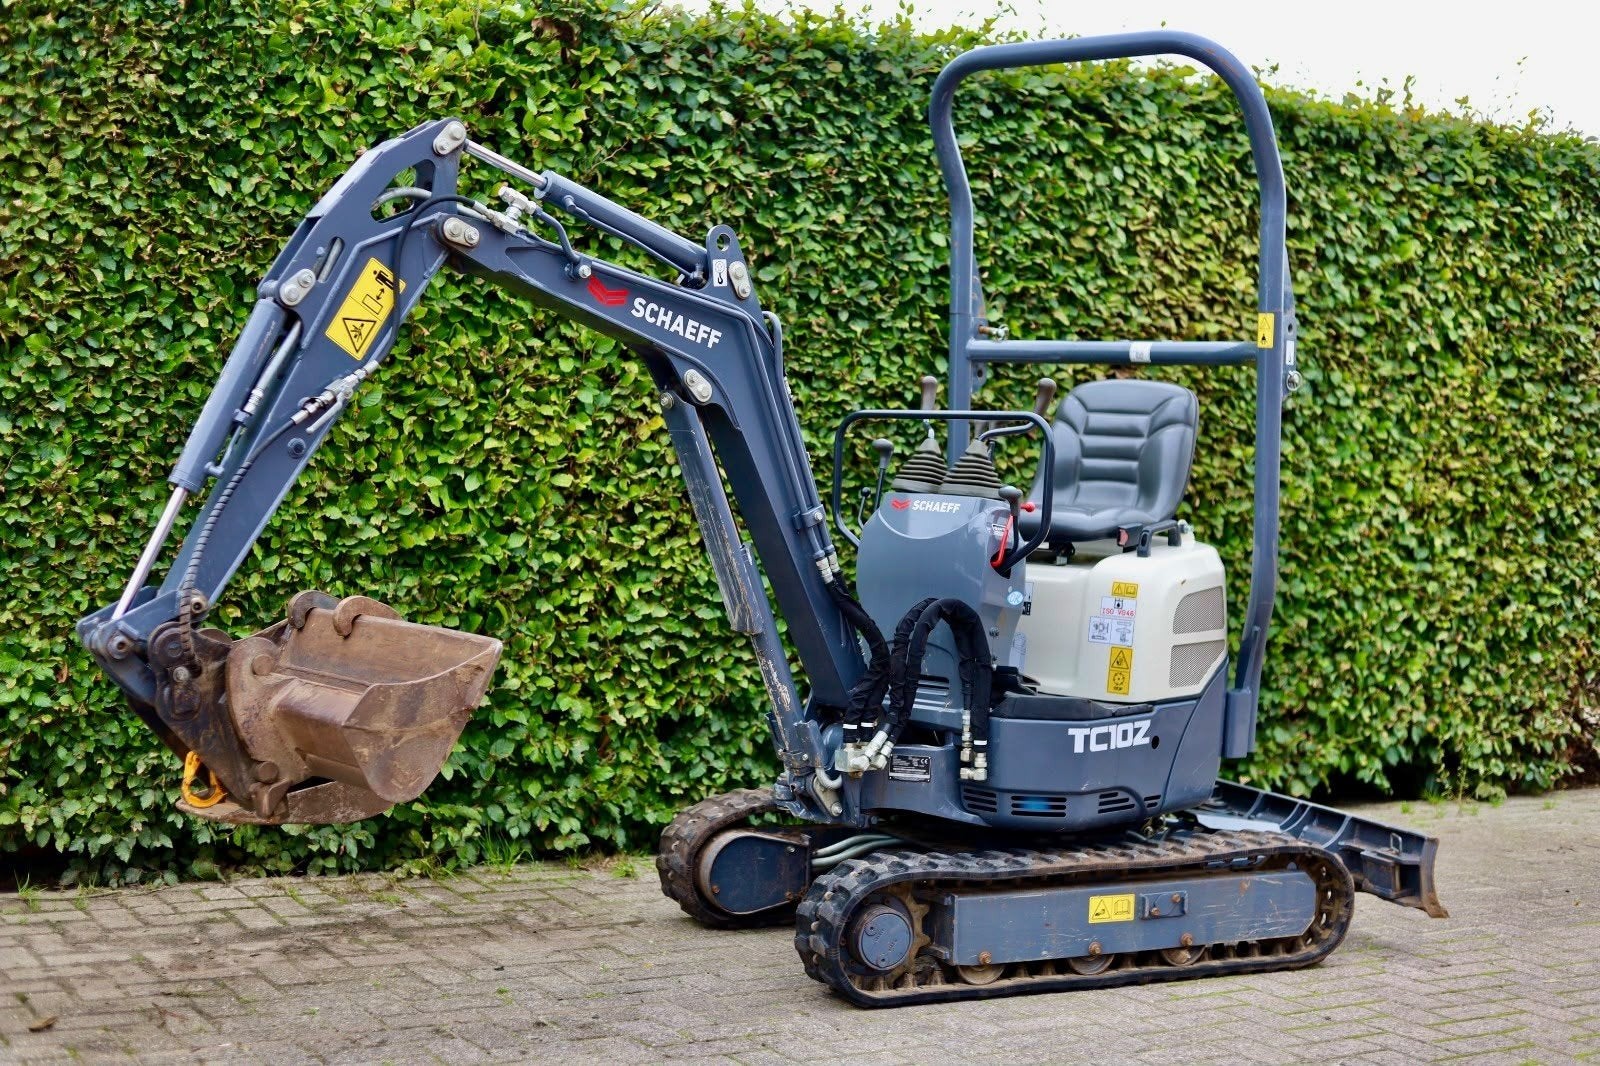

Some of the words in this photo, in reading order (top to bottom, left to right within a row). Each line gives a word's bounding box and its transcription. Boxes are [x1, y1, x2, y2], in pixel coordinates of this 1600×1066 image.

[631, 297, 722, 348] SCHAEFF
[912, 500, 961, 513] SCHAEFF
[1103, 607, 1114, 615] ISO
[1068, 719, 1151, 753] TC10Z
